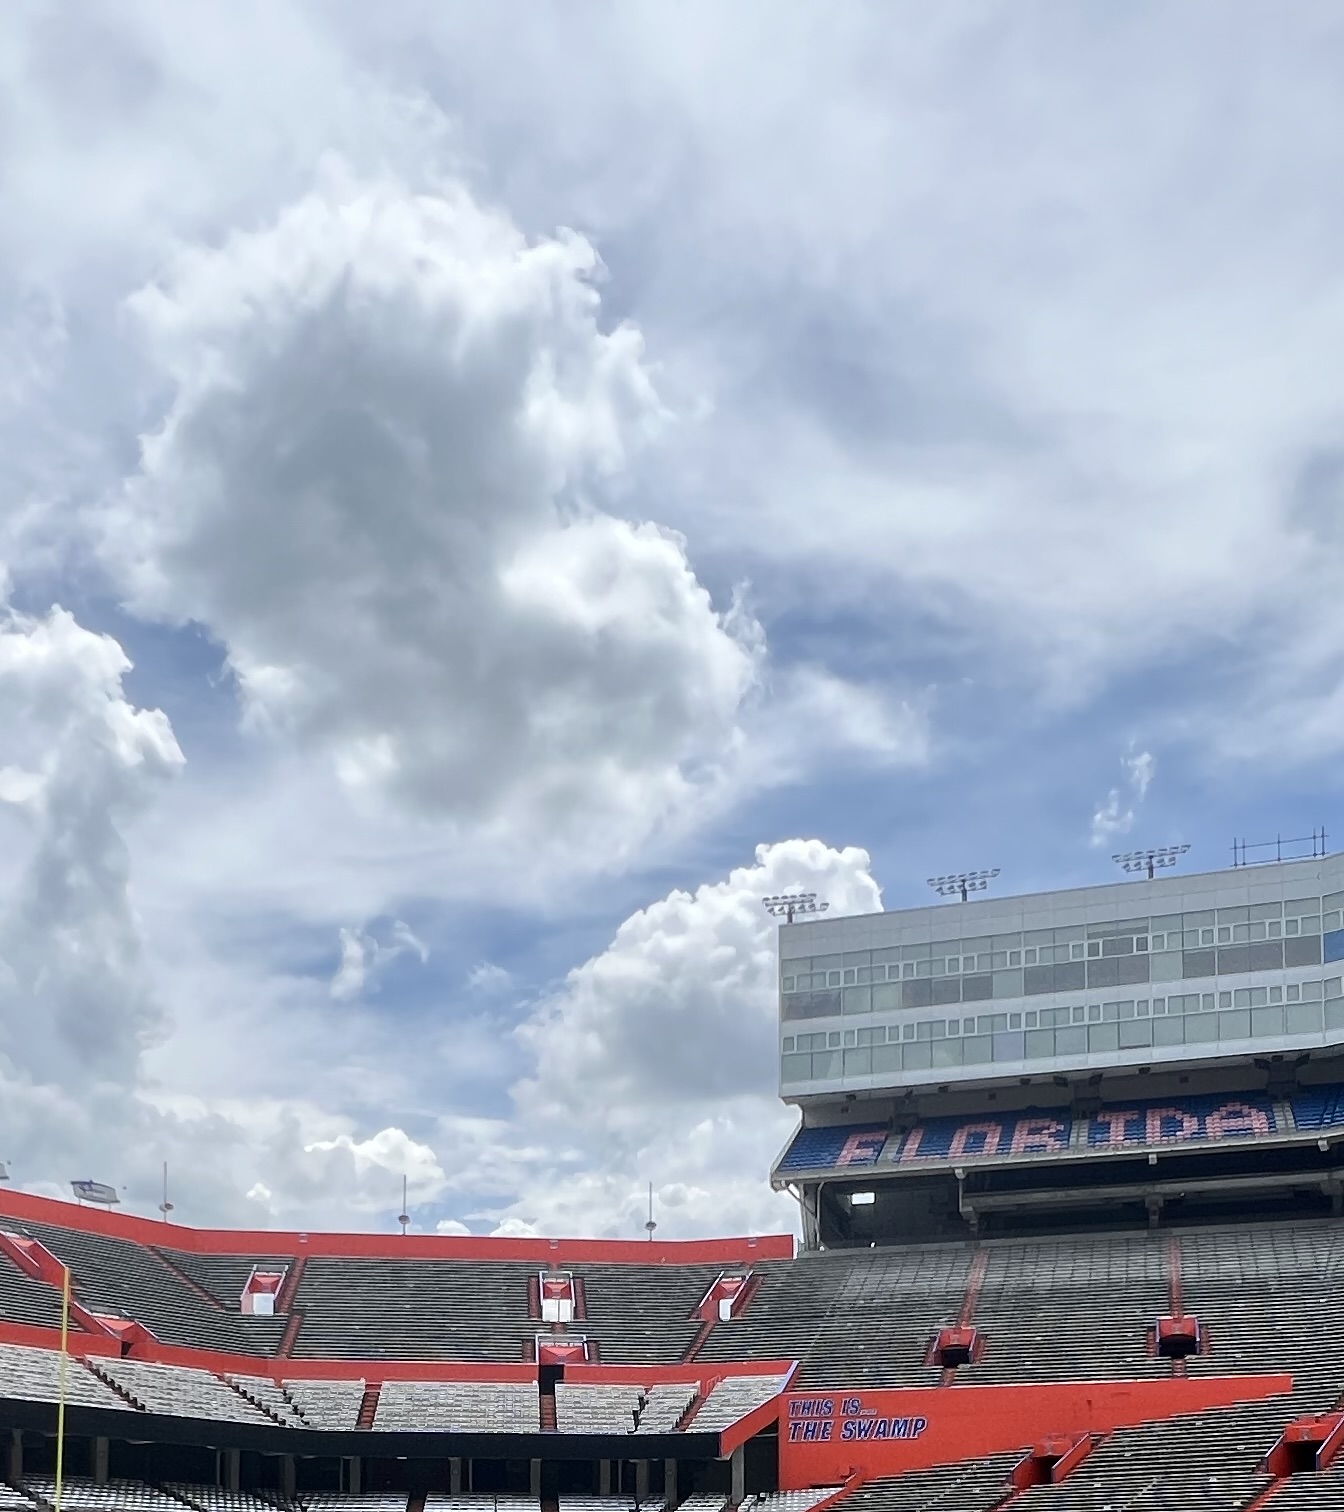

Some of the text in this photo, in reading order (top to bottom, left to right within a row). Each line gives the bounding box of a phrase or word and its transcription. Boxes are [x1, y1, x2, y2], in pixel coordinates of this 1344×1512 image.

[835, 1102, 1271, 1168] FLORIDA
[789, 1398, 834, 1418] THIS
[788, 1417, 928, 1443] THE SWAMP
